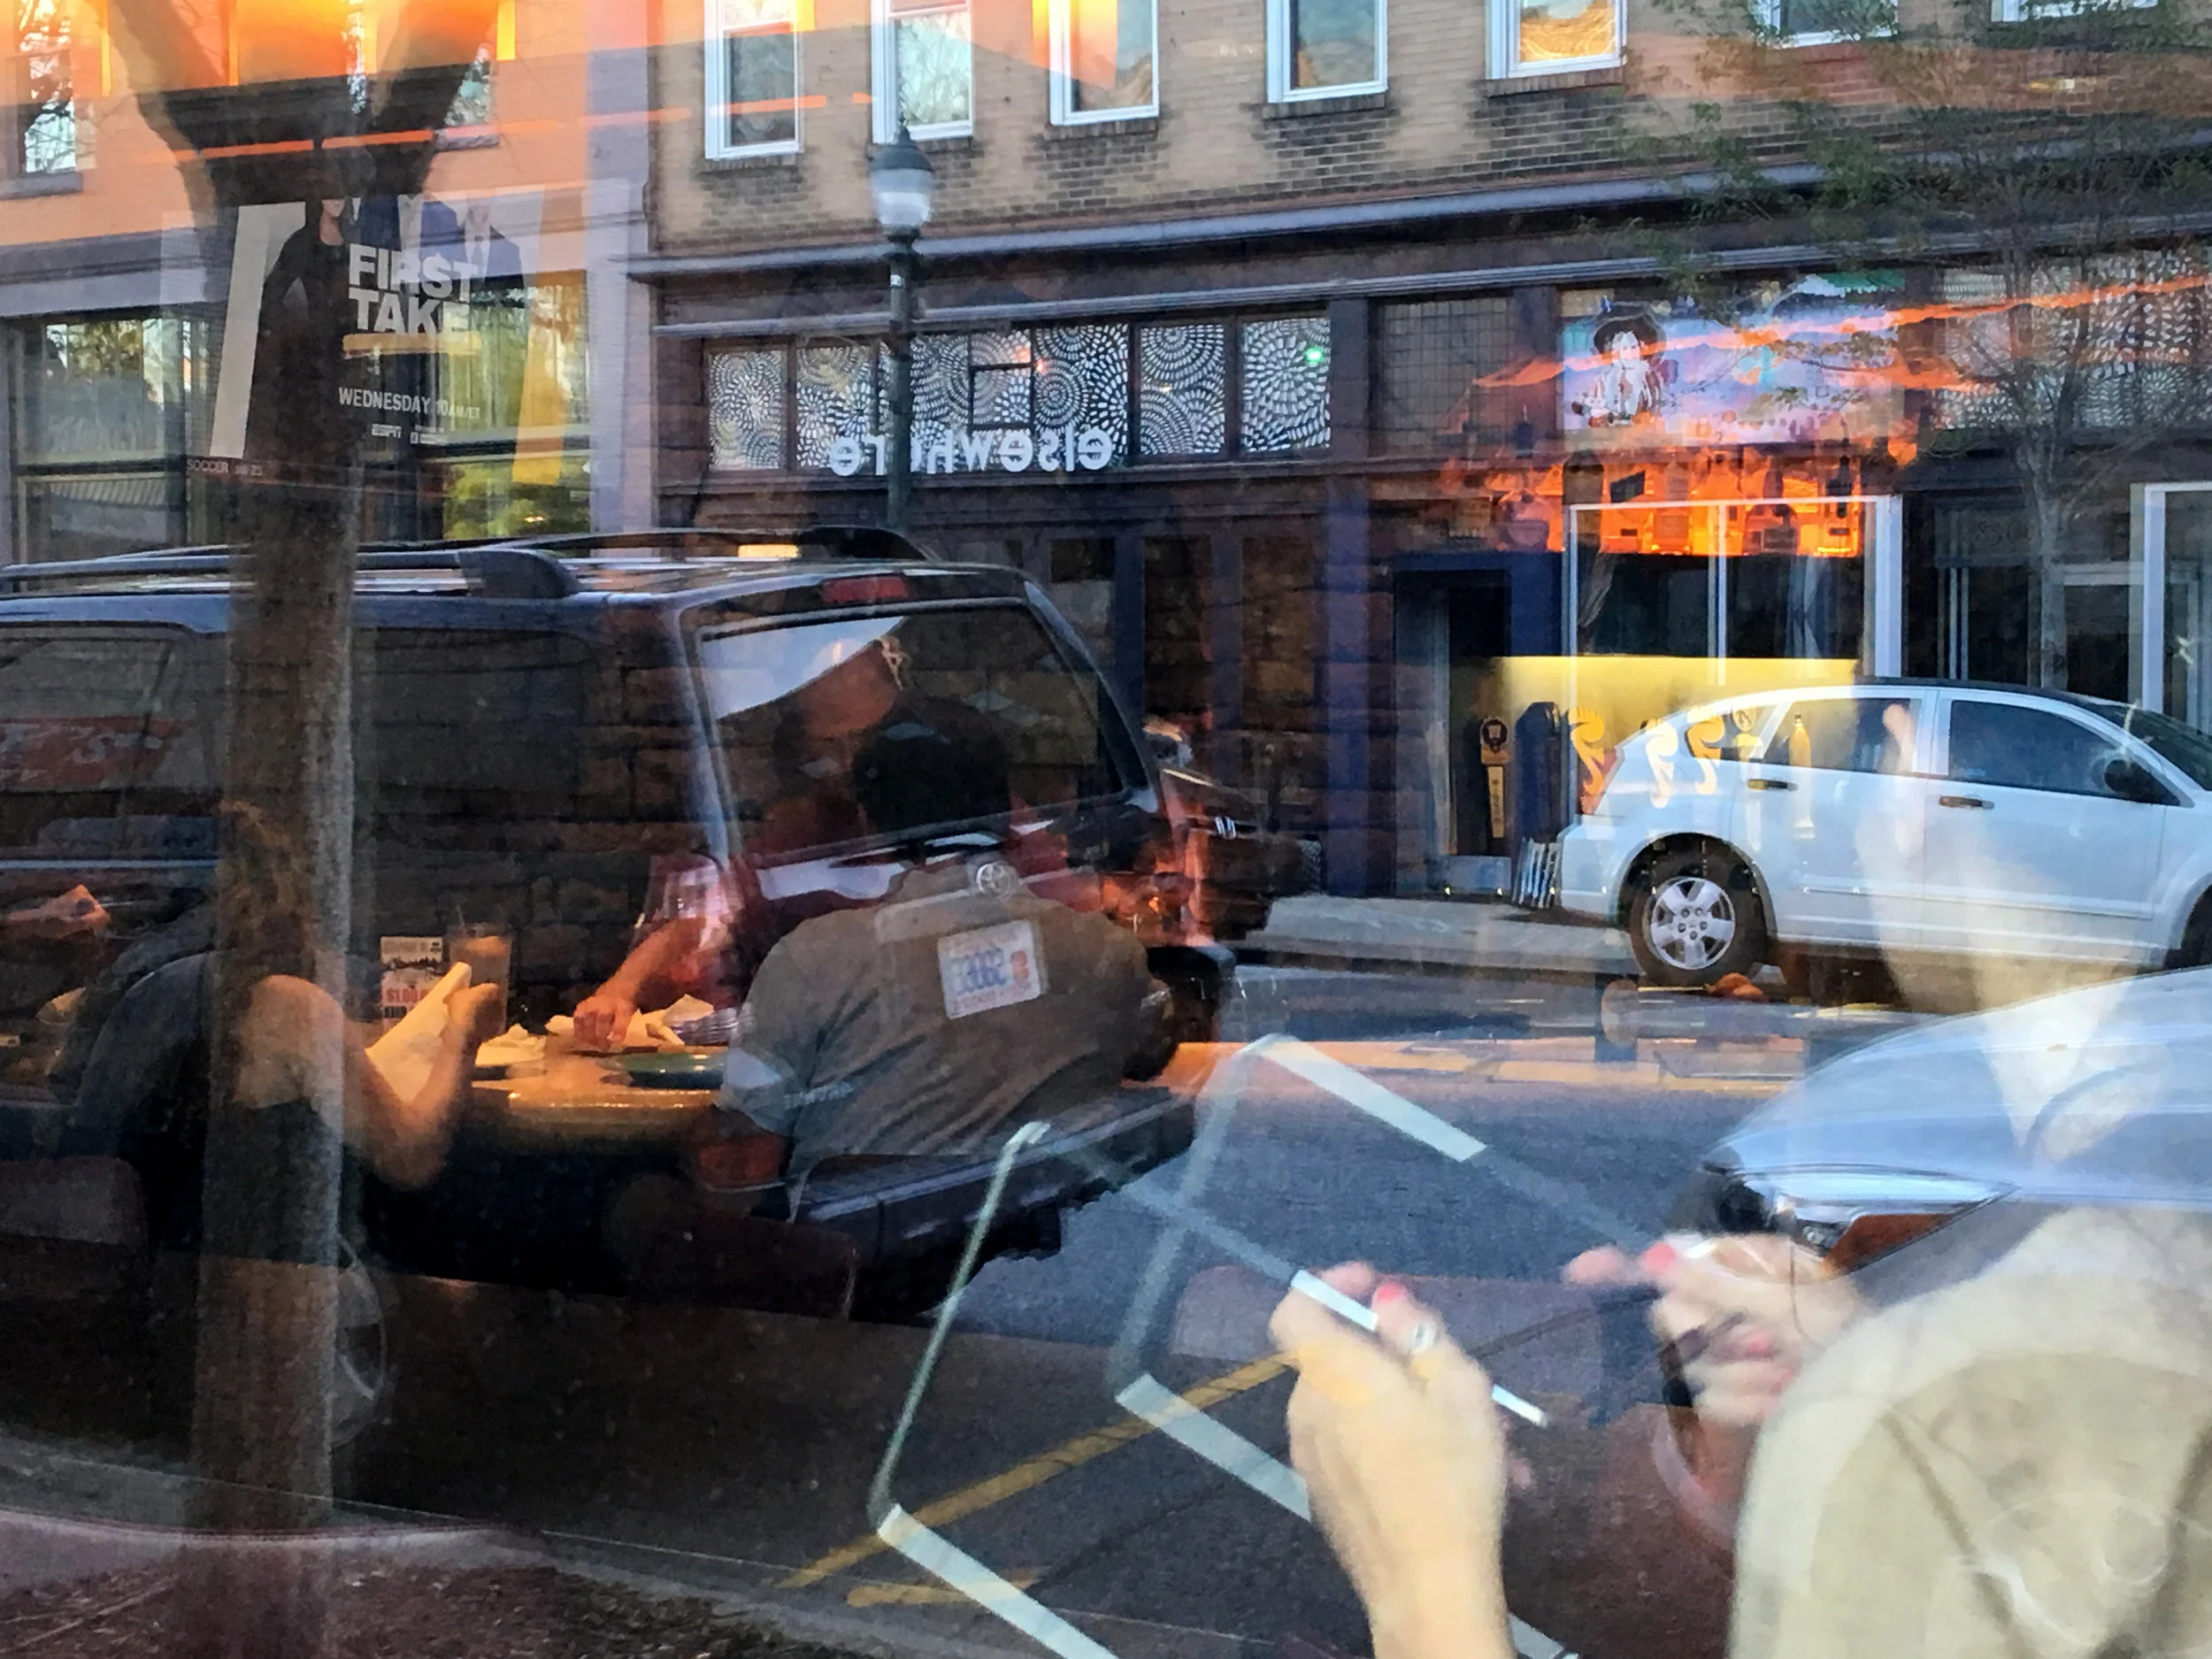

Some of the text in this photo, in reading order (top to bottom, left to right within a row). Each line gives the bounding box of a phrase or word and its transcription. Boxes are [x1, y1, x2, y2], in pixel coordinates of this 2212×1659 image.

[349, 242, 479, 303] FIRST
[348, 287, 471, 343] TAKE
[338, 387, 431, 414] WEDNESDAY
